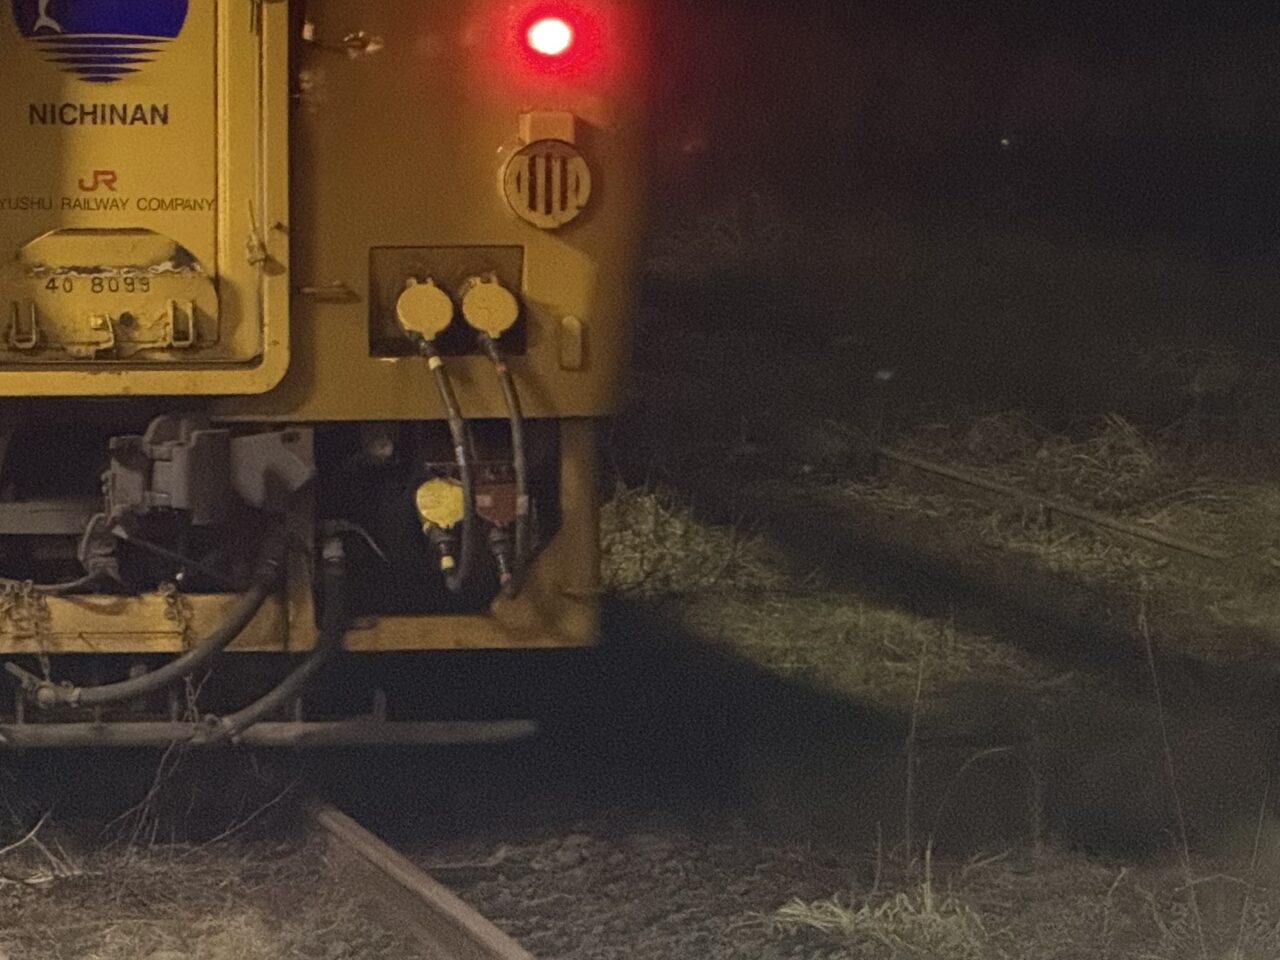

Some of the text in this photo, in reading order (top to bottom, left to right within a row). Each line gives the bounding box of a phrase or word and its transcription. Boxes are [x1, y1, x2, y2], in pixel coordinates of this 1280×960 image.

[28, 103, 169, 125] NICHINAN
[78, 170, 117, 191] JR
[61, 197, 130, 211] RAILWAY
[136, 197, 216, 211] COMPANY
[45, 277, 74, 293] 40
